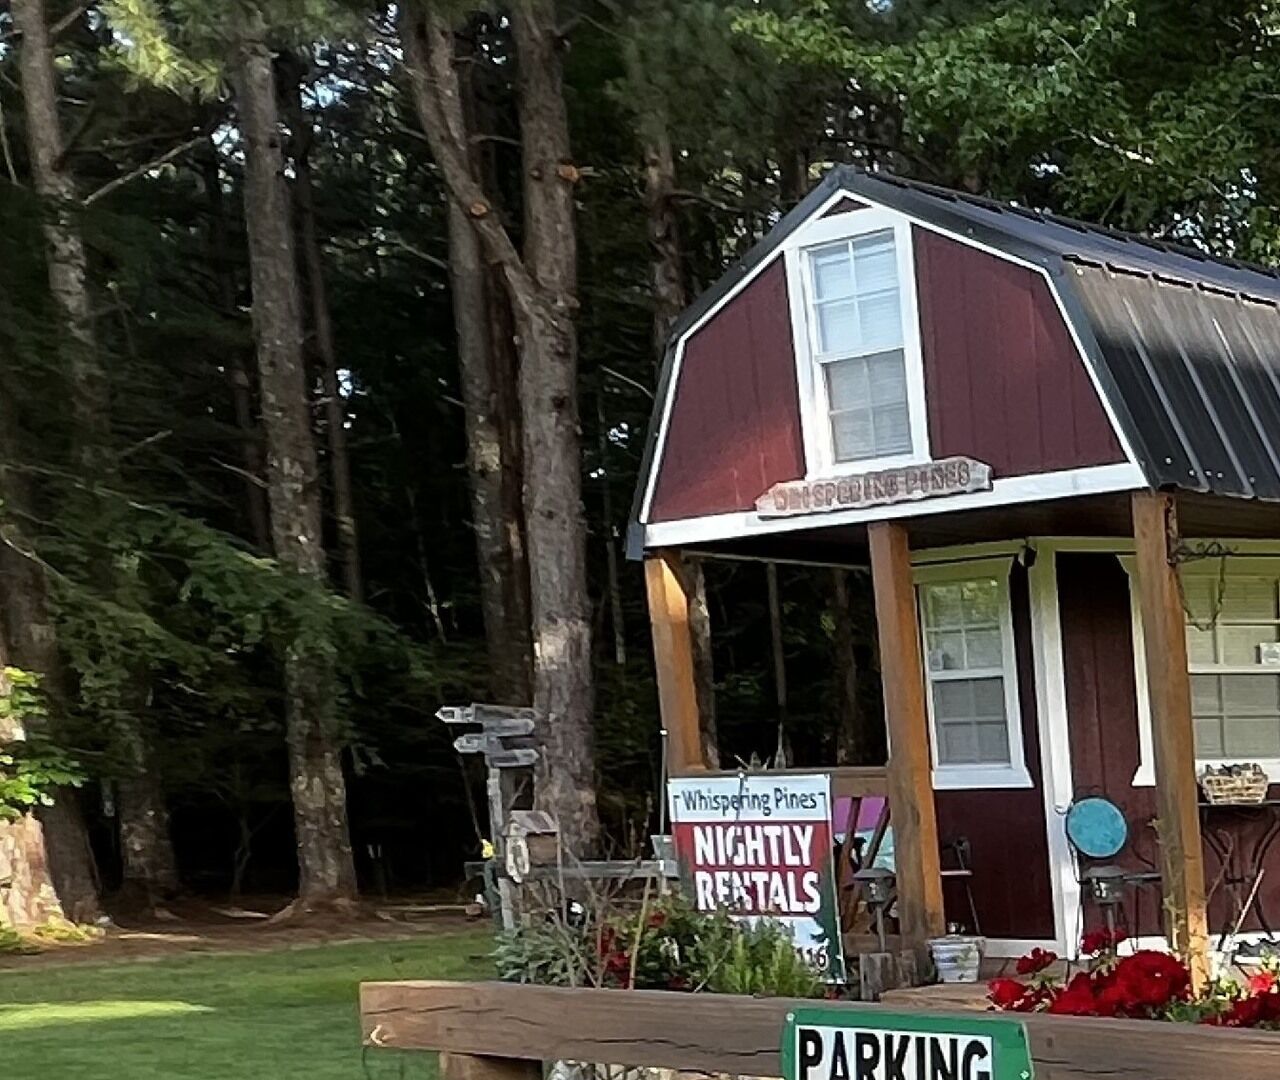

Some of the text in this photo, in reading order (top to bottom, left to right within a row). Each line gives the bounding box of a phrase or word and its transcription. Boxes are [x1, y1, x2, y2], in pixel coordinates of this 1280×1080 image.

[774, 787, 817, 809] Pines
[693, 824, 814, 866] NIGHTLY
[695, 870, 821, 913] RENTALS
